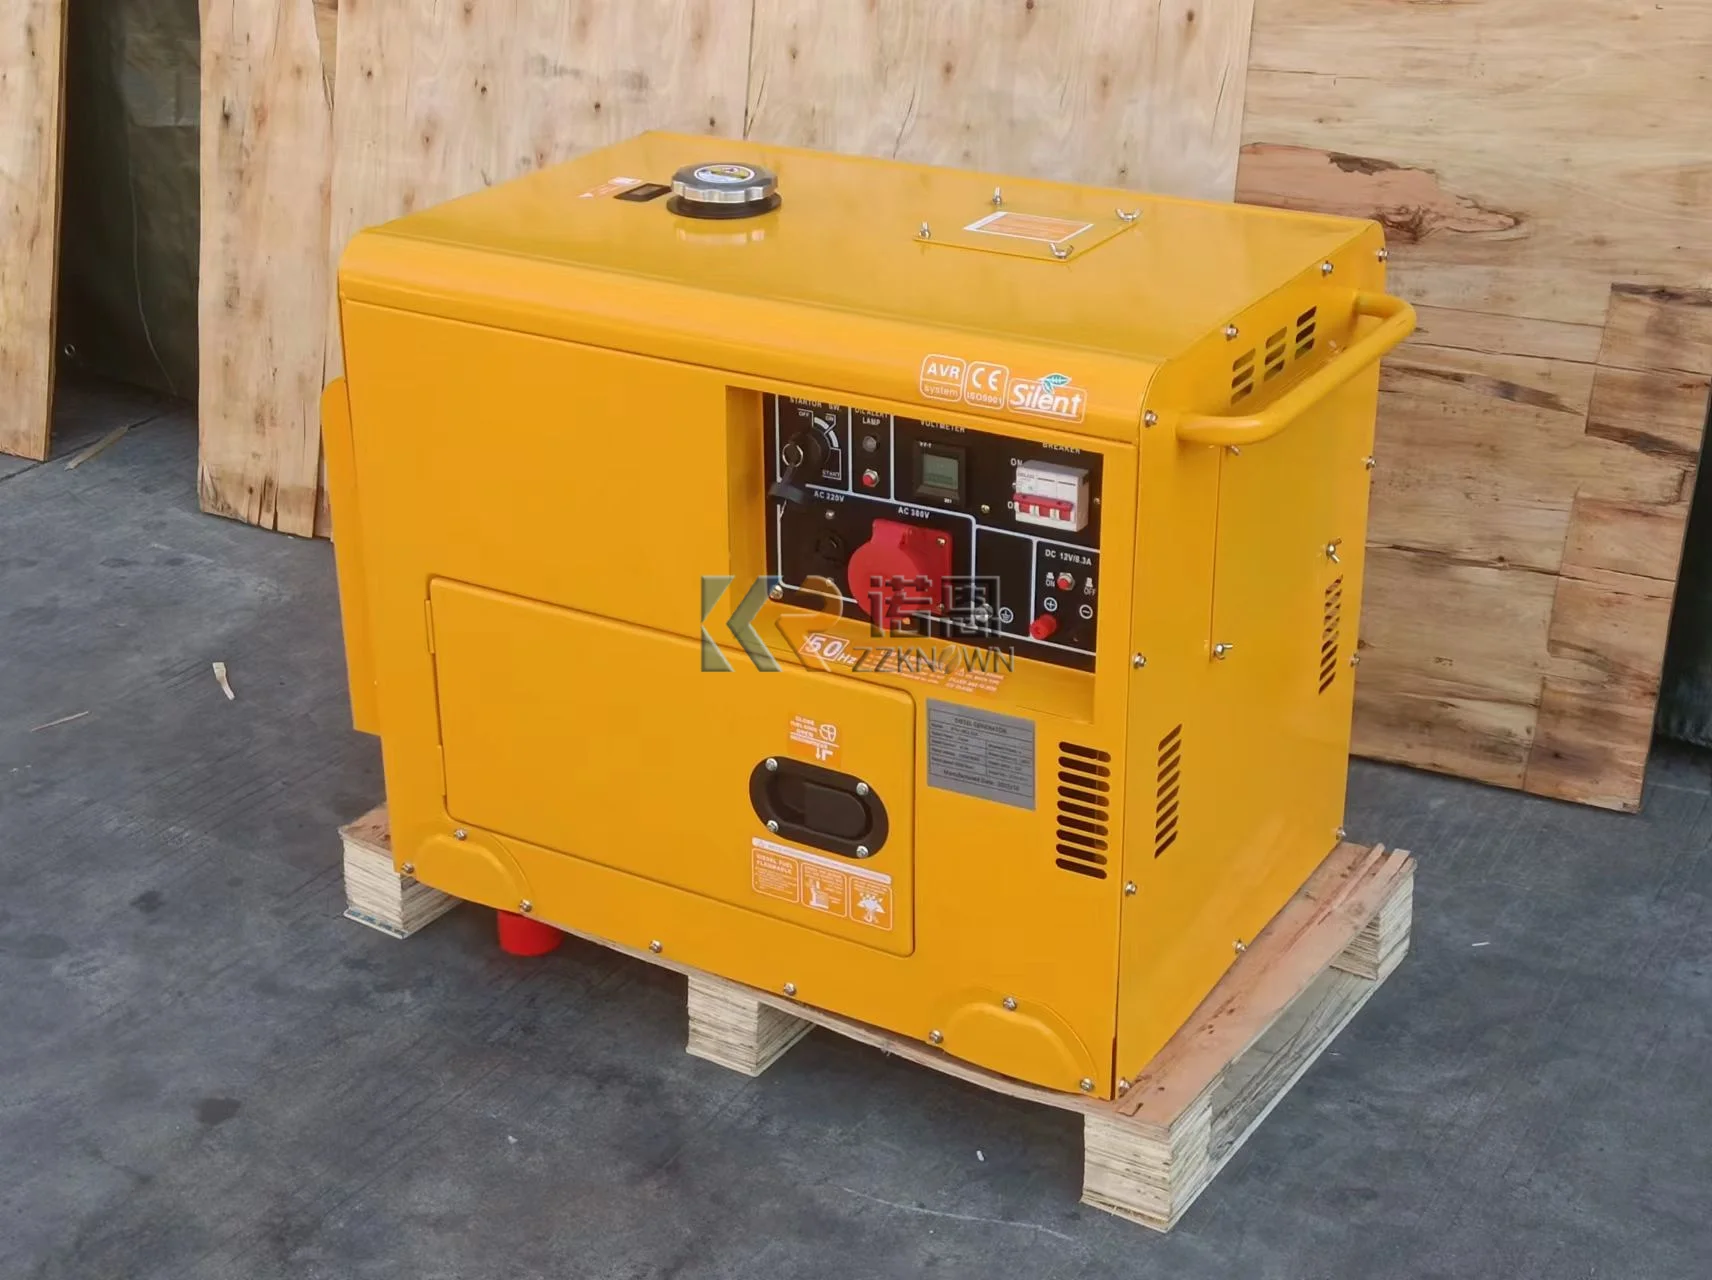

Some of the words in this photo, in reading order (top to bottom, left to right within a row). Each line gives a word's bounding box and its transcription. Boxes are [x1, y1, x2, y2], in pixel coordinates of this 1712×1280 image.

[927, 362, 960, 380] AVR
[971, 367, 1002, 392] CE
[923, 383, 959, 398] system
[1011, 382, 1084, 415] Silent
[862, 417, 881, 426] LAMP
[813, 490, 825, 499] AC
[826, 492, 845, 502] 220V
[897, 506, 909, 515] AC
[911, 509, 931, 520] 380V
[1044, 549, 1057, 558] DC
[1044, 579, 1056, 588] ON
[1083, 587, 1096, 597] OFF
[806, 636, 842, 658] 50
[837, 652, 858, 666] Hz
